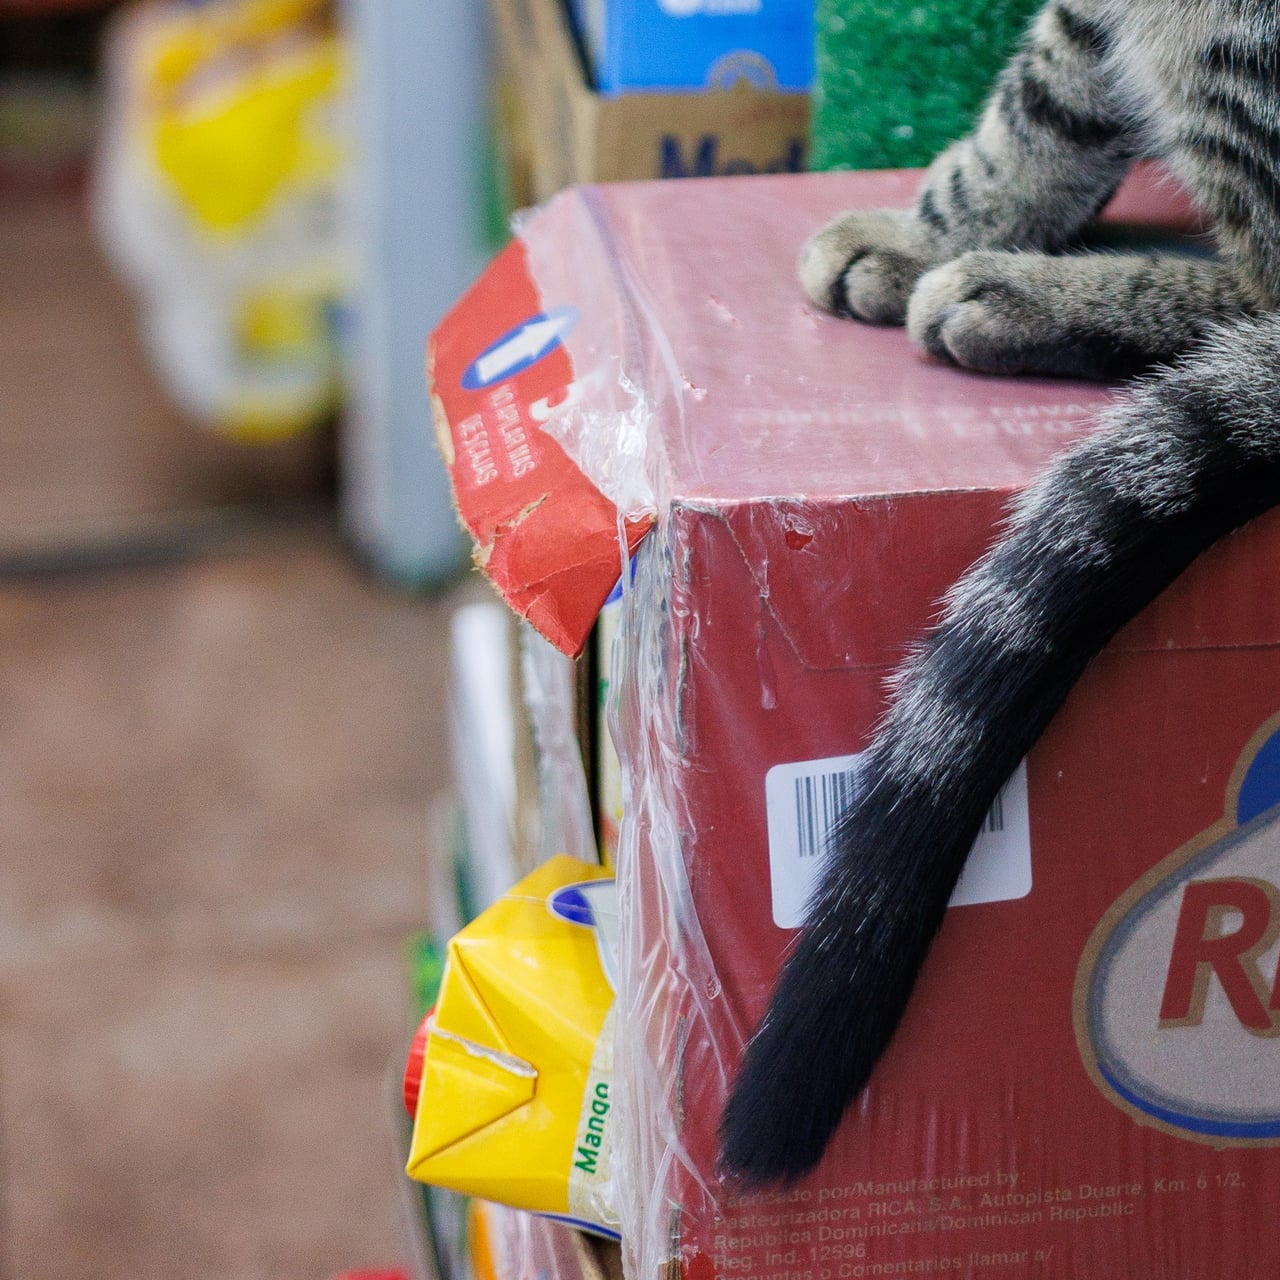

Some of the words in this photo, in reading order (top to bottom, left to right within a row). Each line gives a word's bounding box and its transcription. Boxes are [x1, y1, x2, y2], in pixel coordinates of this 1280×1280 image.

[574, 1081, 611, 1175] Mango
[980, 1187, 1073, 1211] Autopista
[1050, 1200, 1135, 1223] Republic
